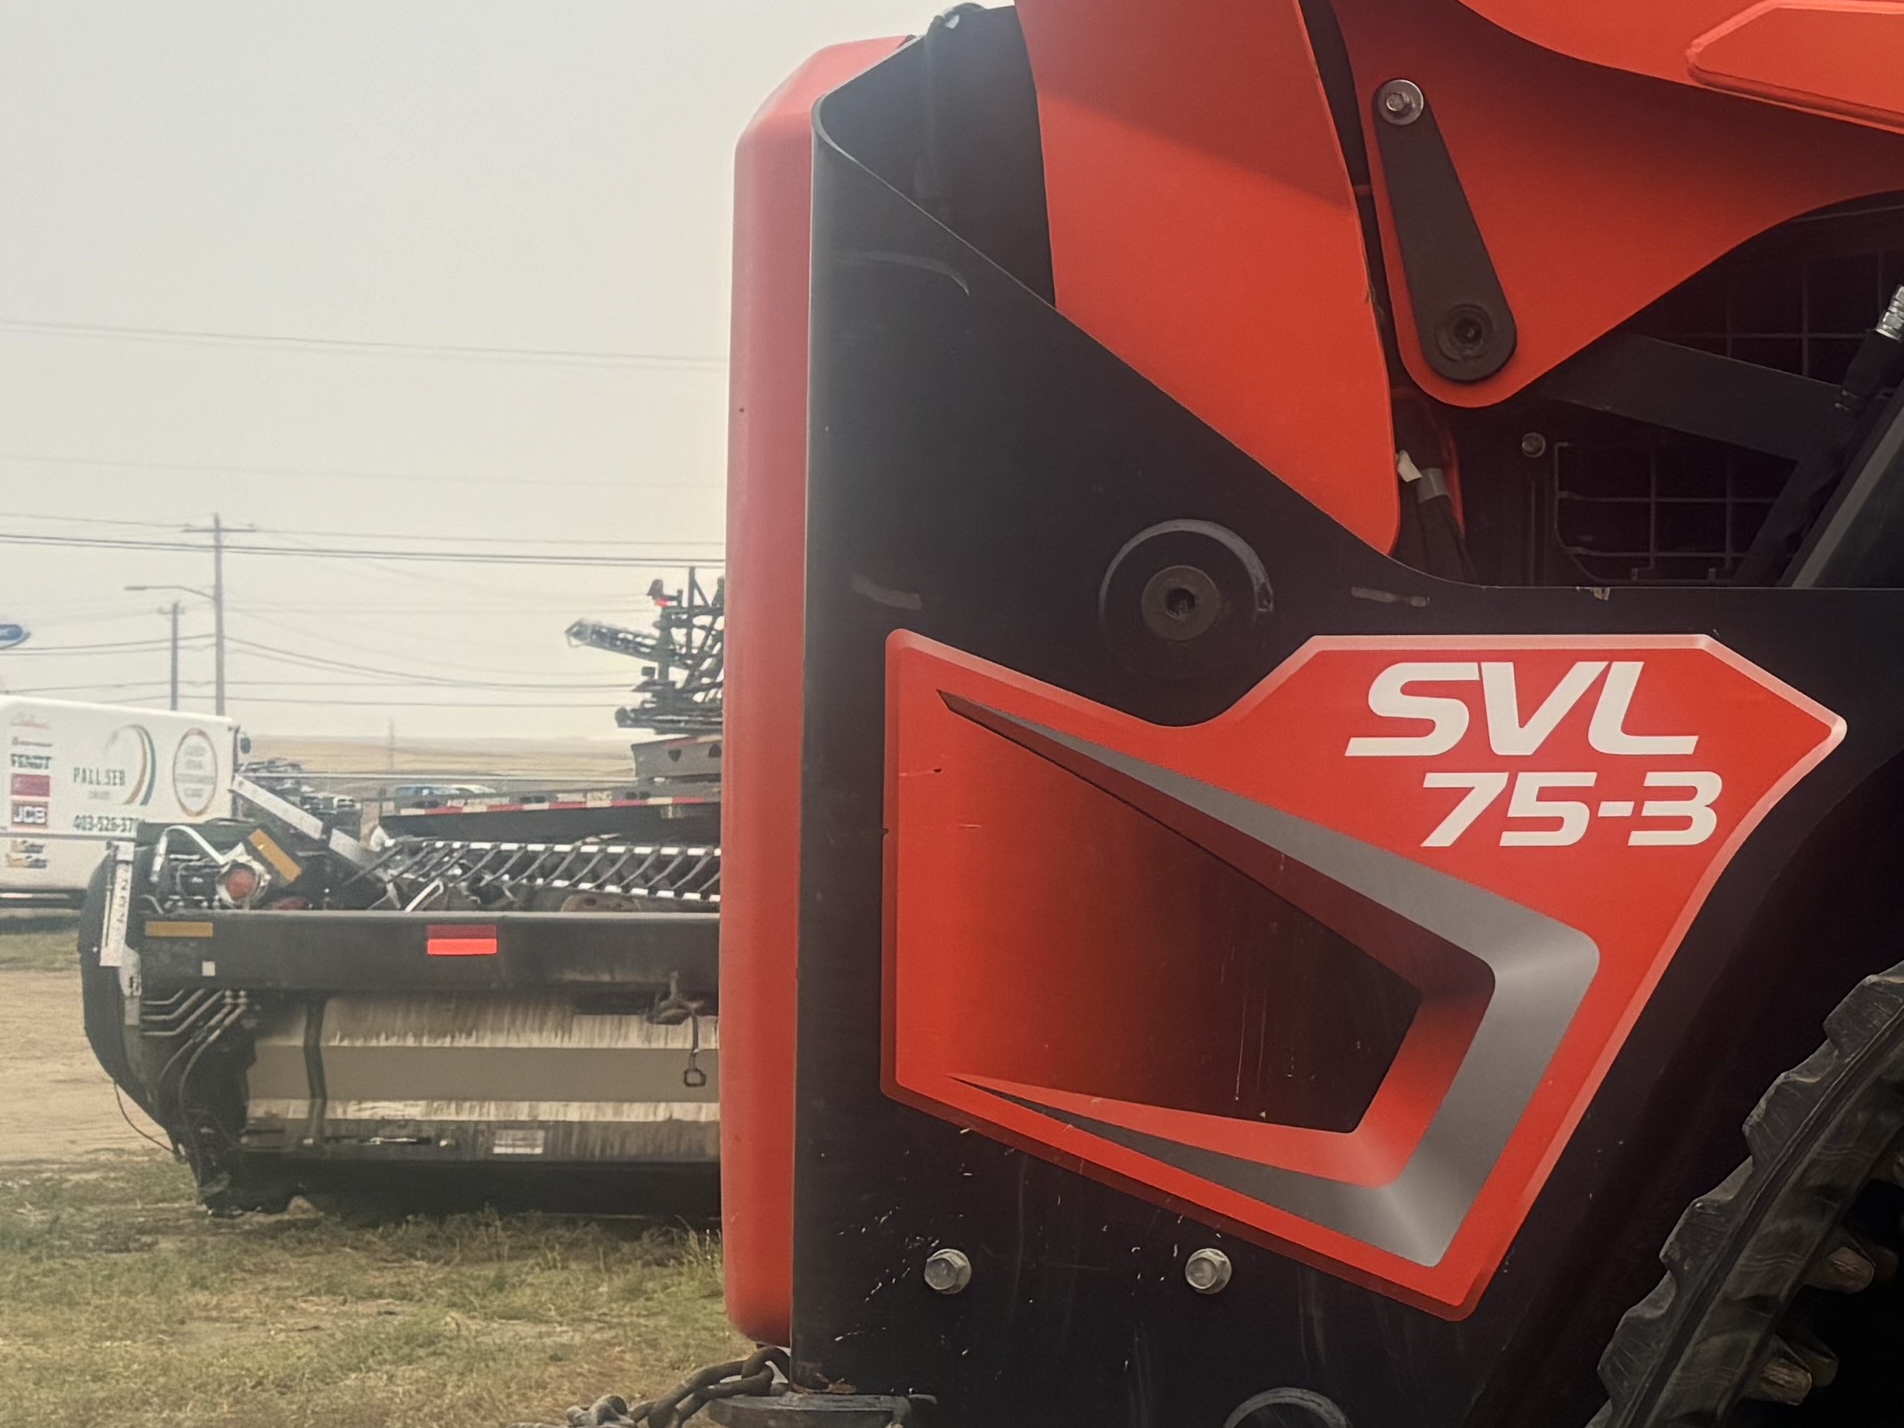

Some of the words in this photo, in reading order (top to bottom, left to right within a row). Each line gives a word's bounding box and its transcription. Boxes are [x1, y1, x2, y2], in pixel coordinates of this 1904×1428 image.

[1344, 660, 1700, 757] SVL
[73, 766, 126, 787] PALLSER
[15, 805, 48, 824] JCB
[1419, 771, 1724, 848] 75-3
